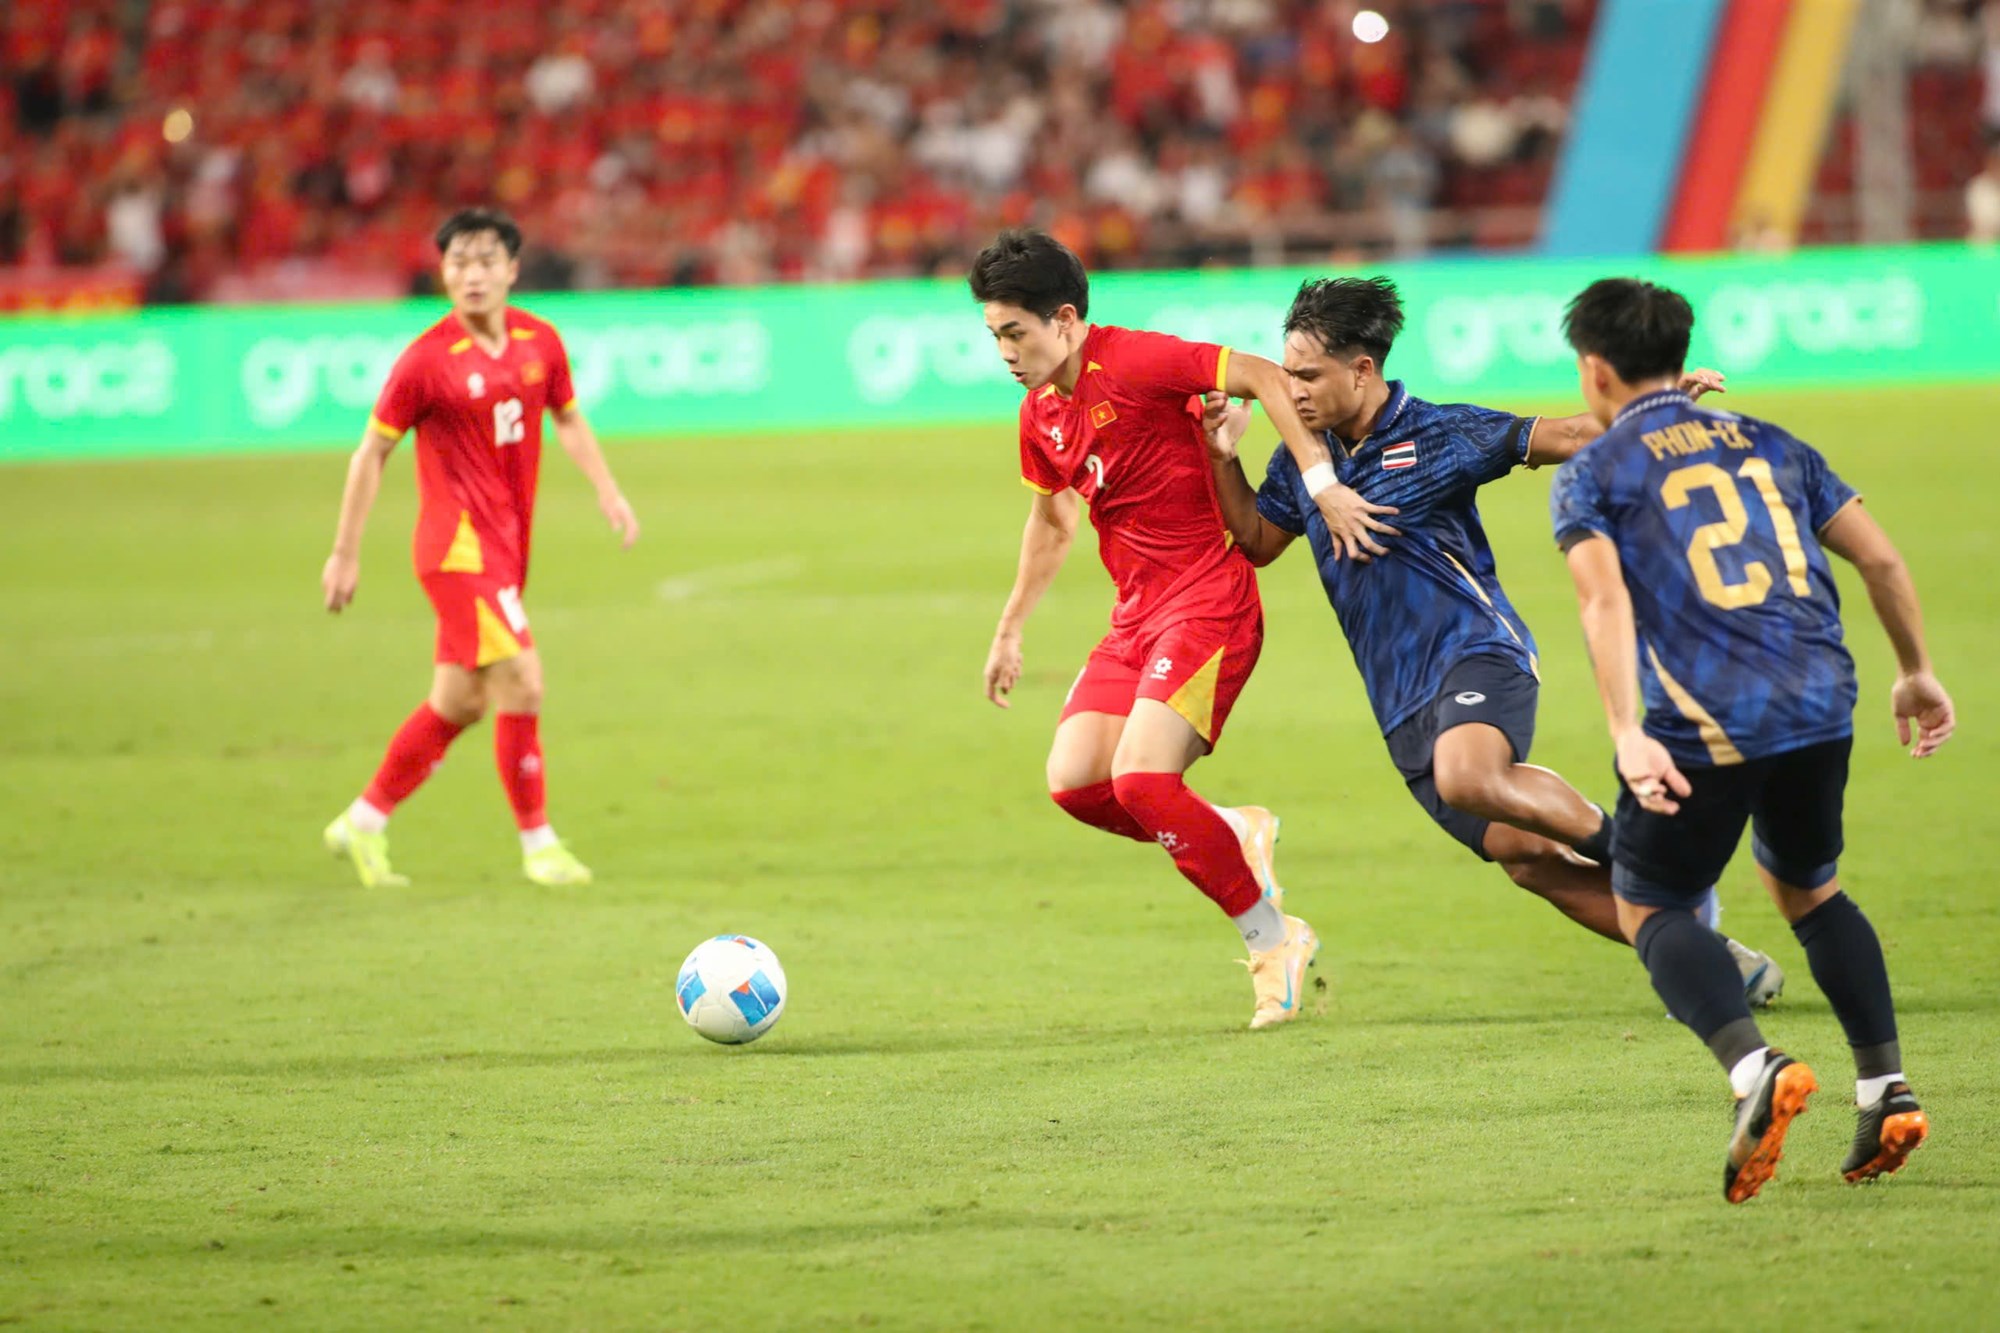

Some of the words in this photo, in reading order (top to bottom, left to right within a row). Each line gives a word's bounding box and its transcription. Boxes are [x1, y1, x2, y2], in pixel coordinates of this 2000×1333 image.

[243, 336, 412, 427] gra
[848, 314, 1005, 402] gra
[493, 397, 525, 448] 12
[1660, 457, 1812, 610] 21
